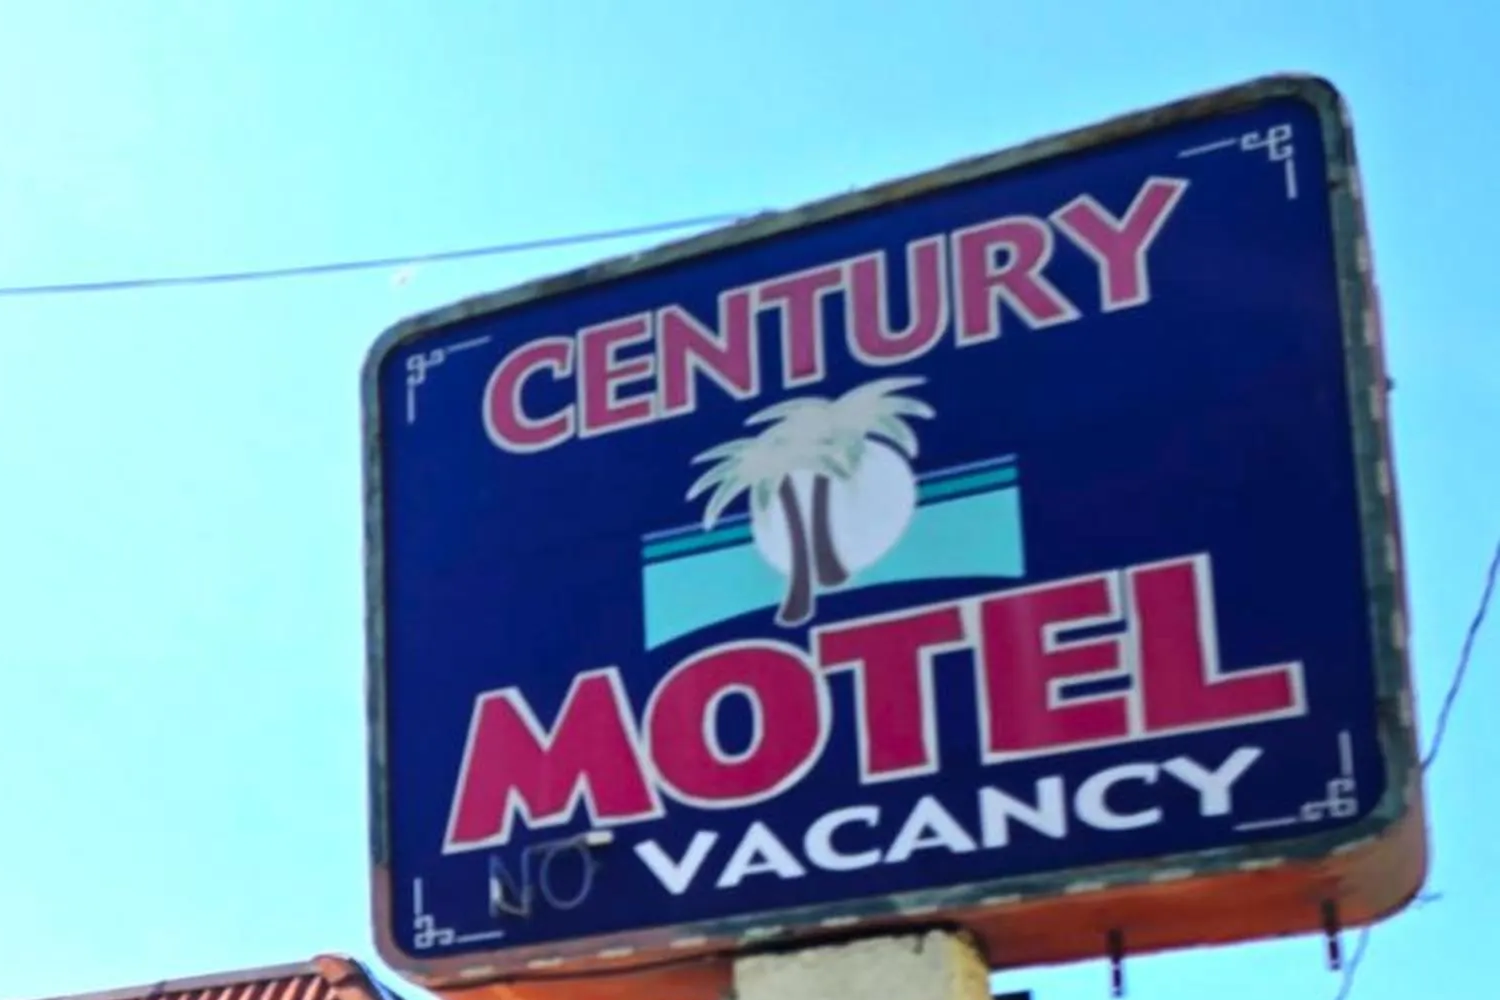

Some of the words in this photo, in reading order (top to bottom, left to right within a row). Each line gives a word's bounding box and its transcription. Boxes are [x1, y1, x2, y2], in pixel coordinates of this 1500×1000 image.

[483, 177, 1188, 452] CENTURY
[443, 553, 1306, 854] MOTEL
[489, 841, 594, 918] NO
[634, 748, 1261, 895] VACANCY
